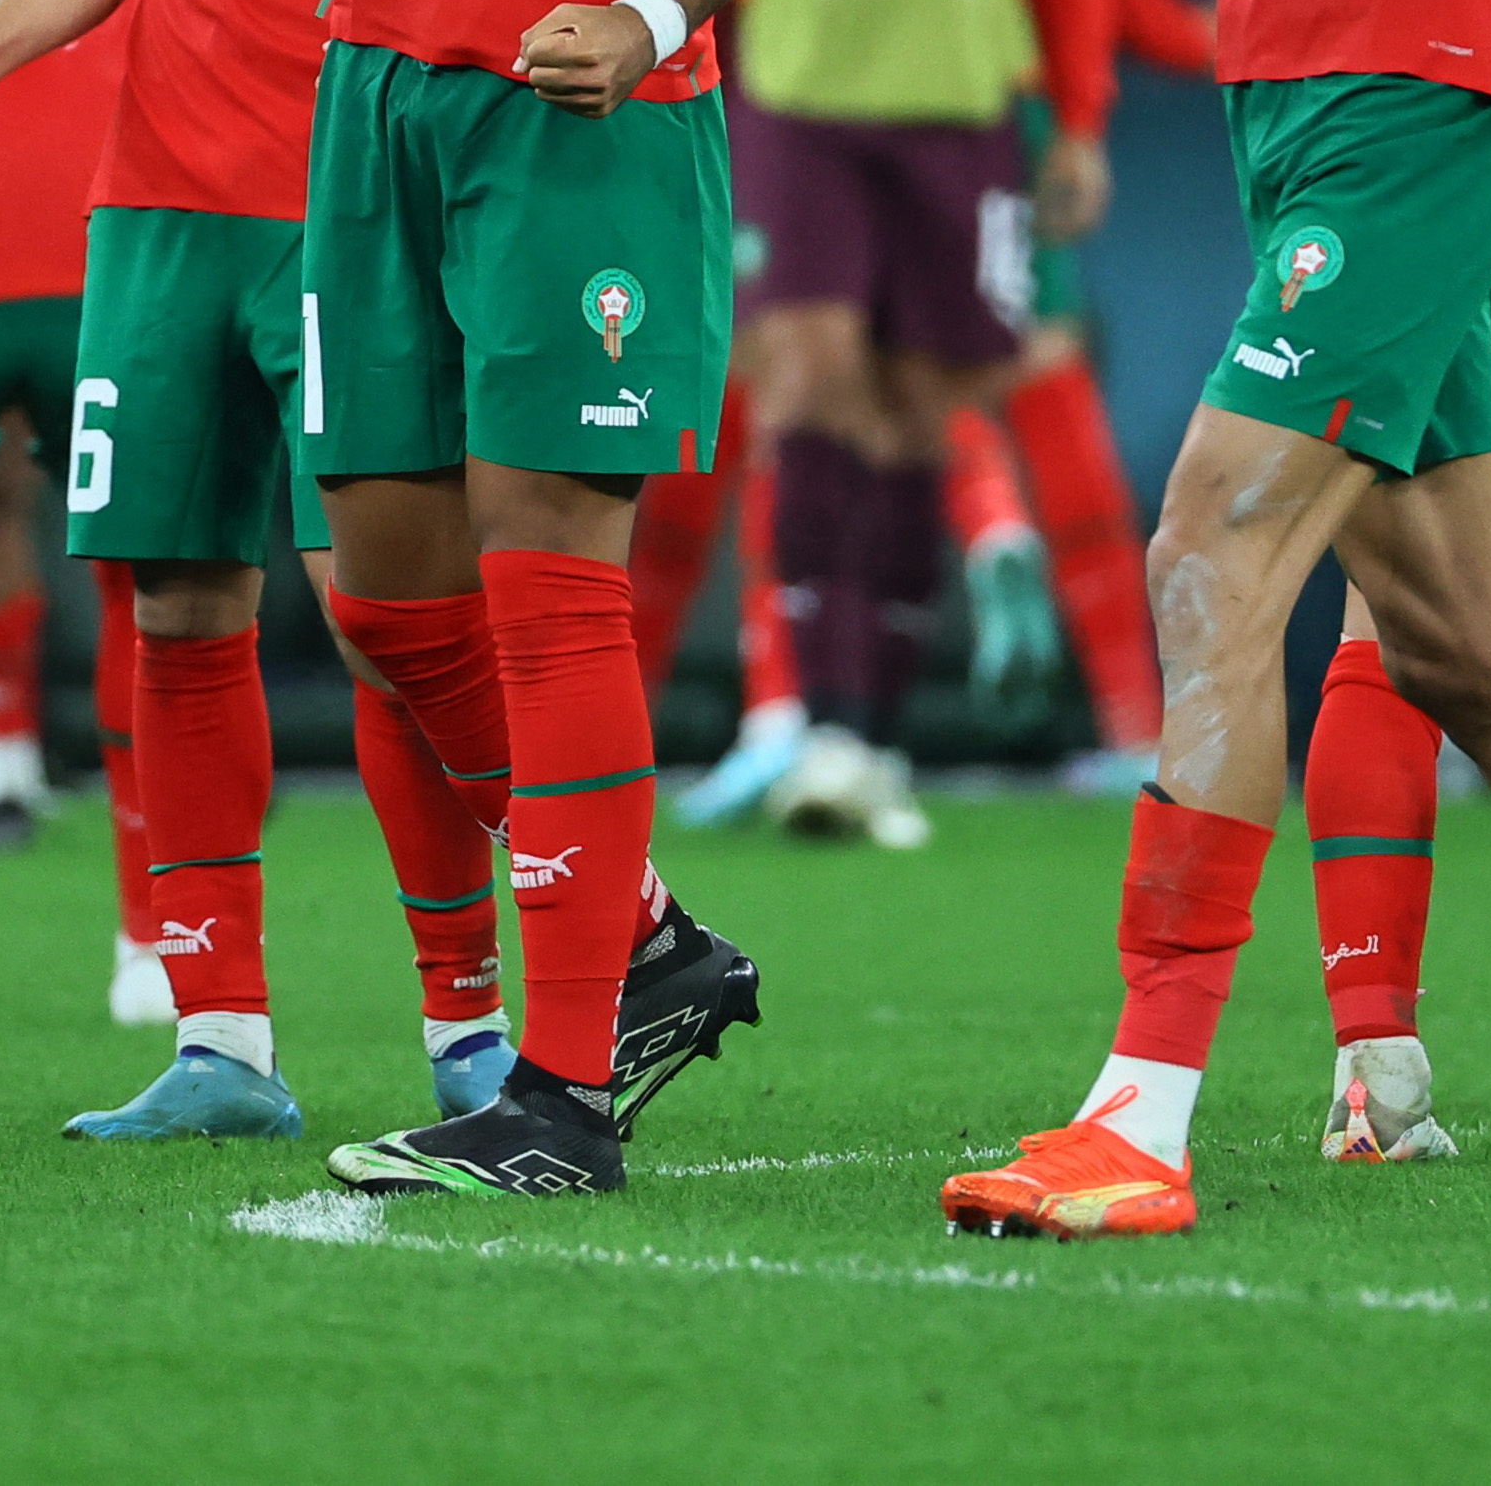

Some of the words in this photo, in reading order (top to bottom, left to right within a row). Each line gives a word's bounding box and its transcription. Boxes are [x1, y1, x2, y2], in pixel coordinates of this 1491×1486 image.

[1233, 343, 1291, 380] PUMA
[581, 404, 639, 427] PUMA
[154, 937, 200, 956] UMA
